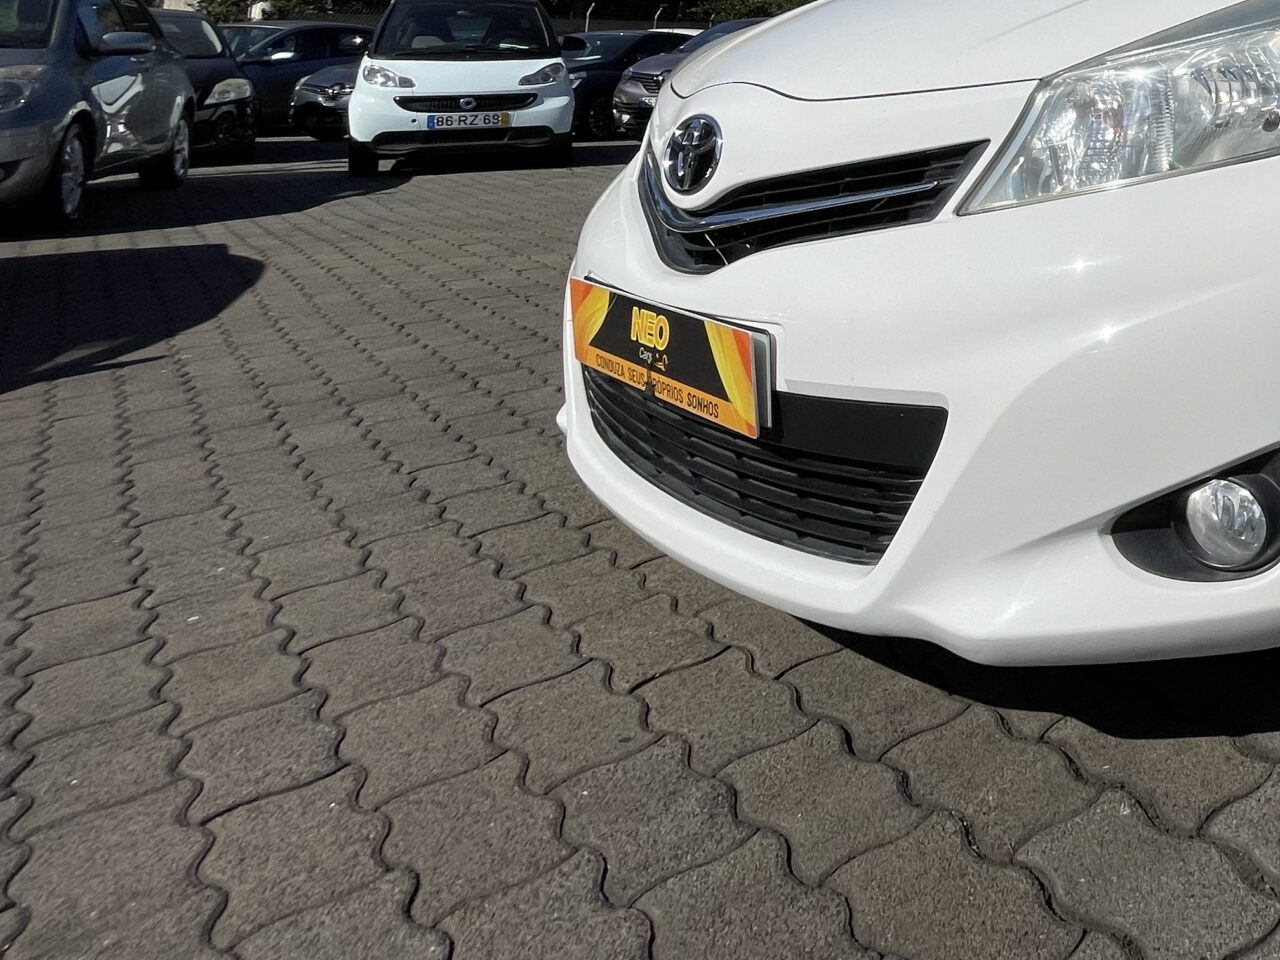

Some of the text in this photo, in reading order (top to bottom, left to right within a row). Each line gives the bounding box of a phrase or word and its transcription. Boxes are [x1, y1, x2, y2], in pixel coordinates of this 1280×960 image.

[436, 115, 454, 127] 86
[458, 114, 479, 126] RZ
[630, 306, 670, 350] NEO
[596, 353, 719, 419] CONDUZA SEUS RÓPRIOS SONHOS
